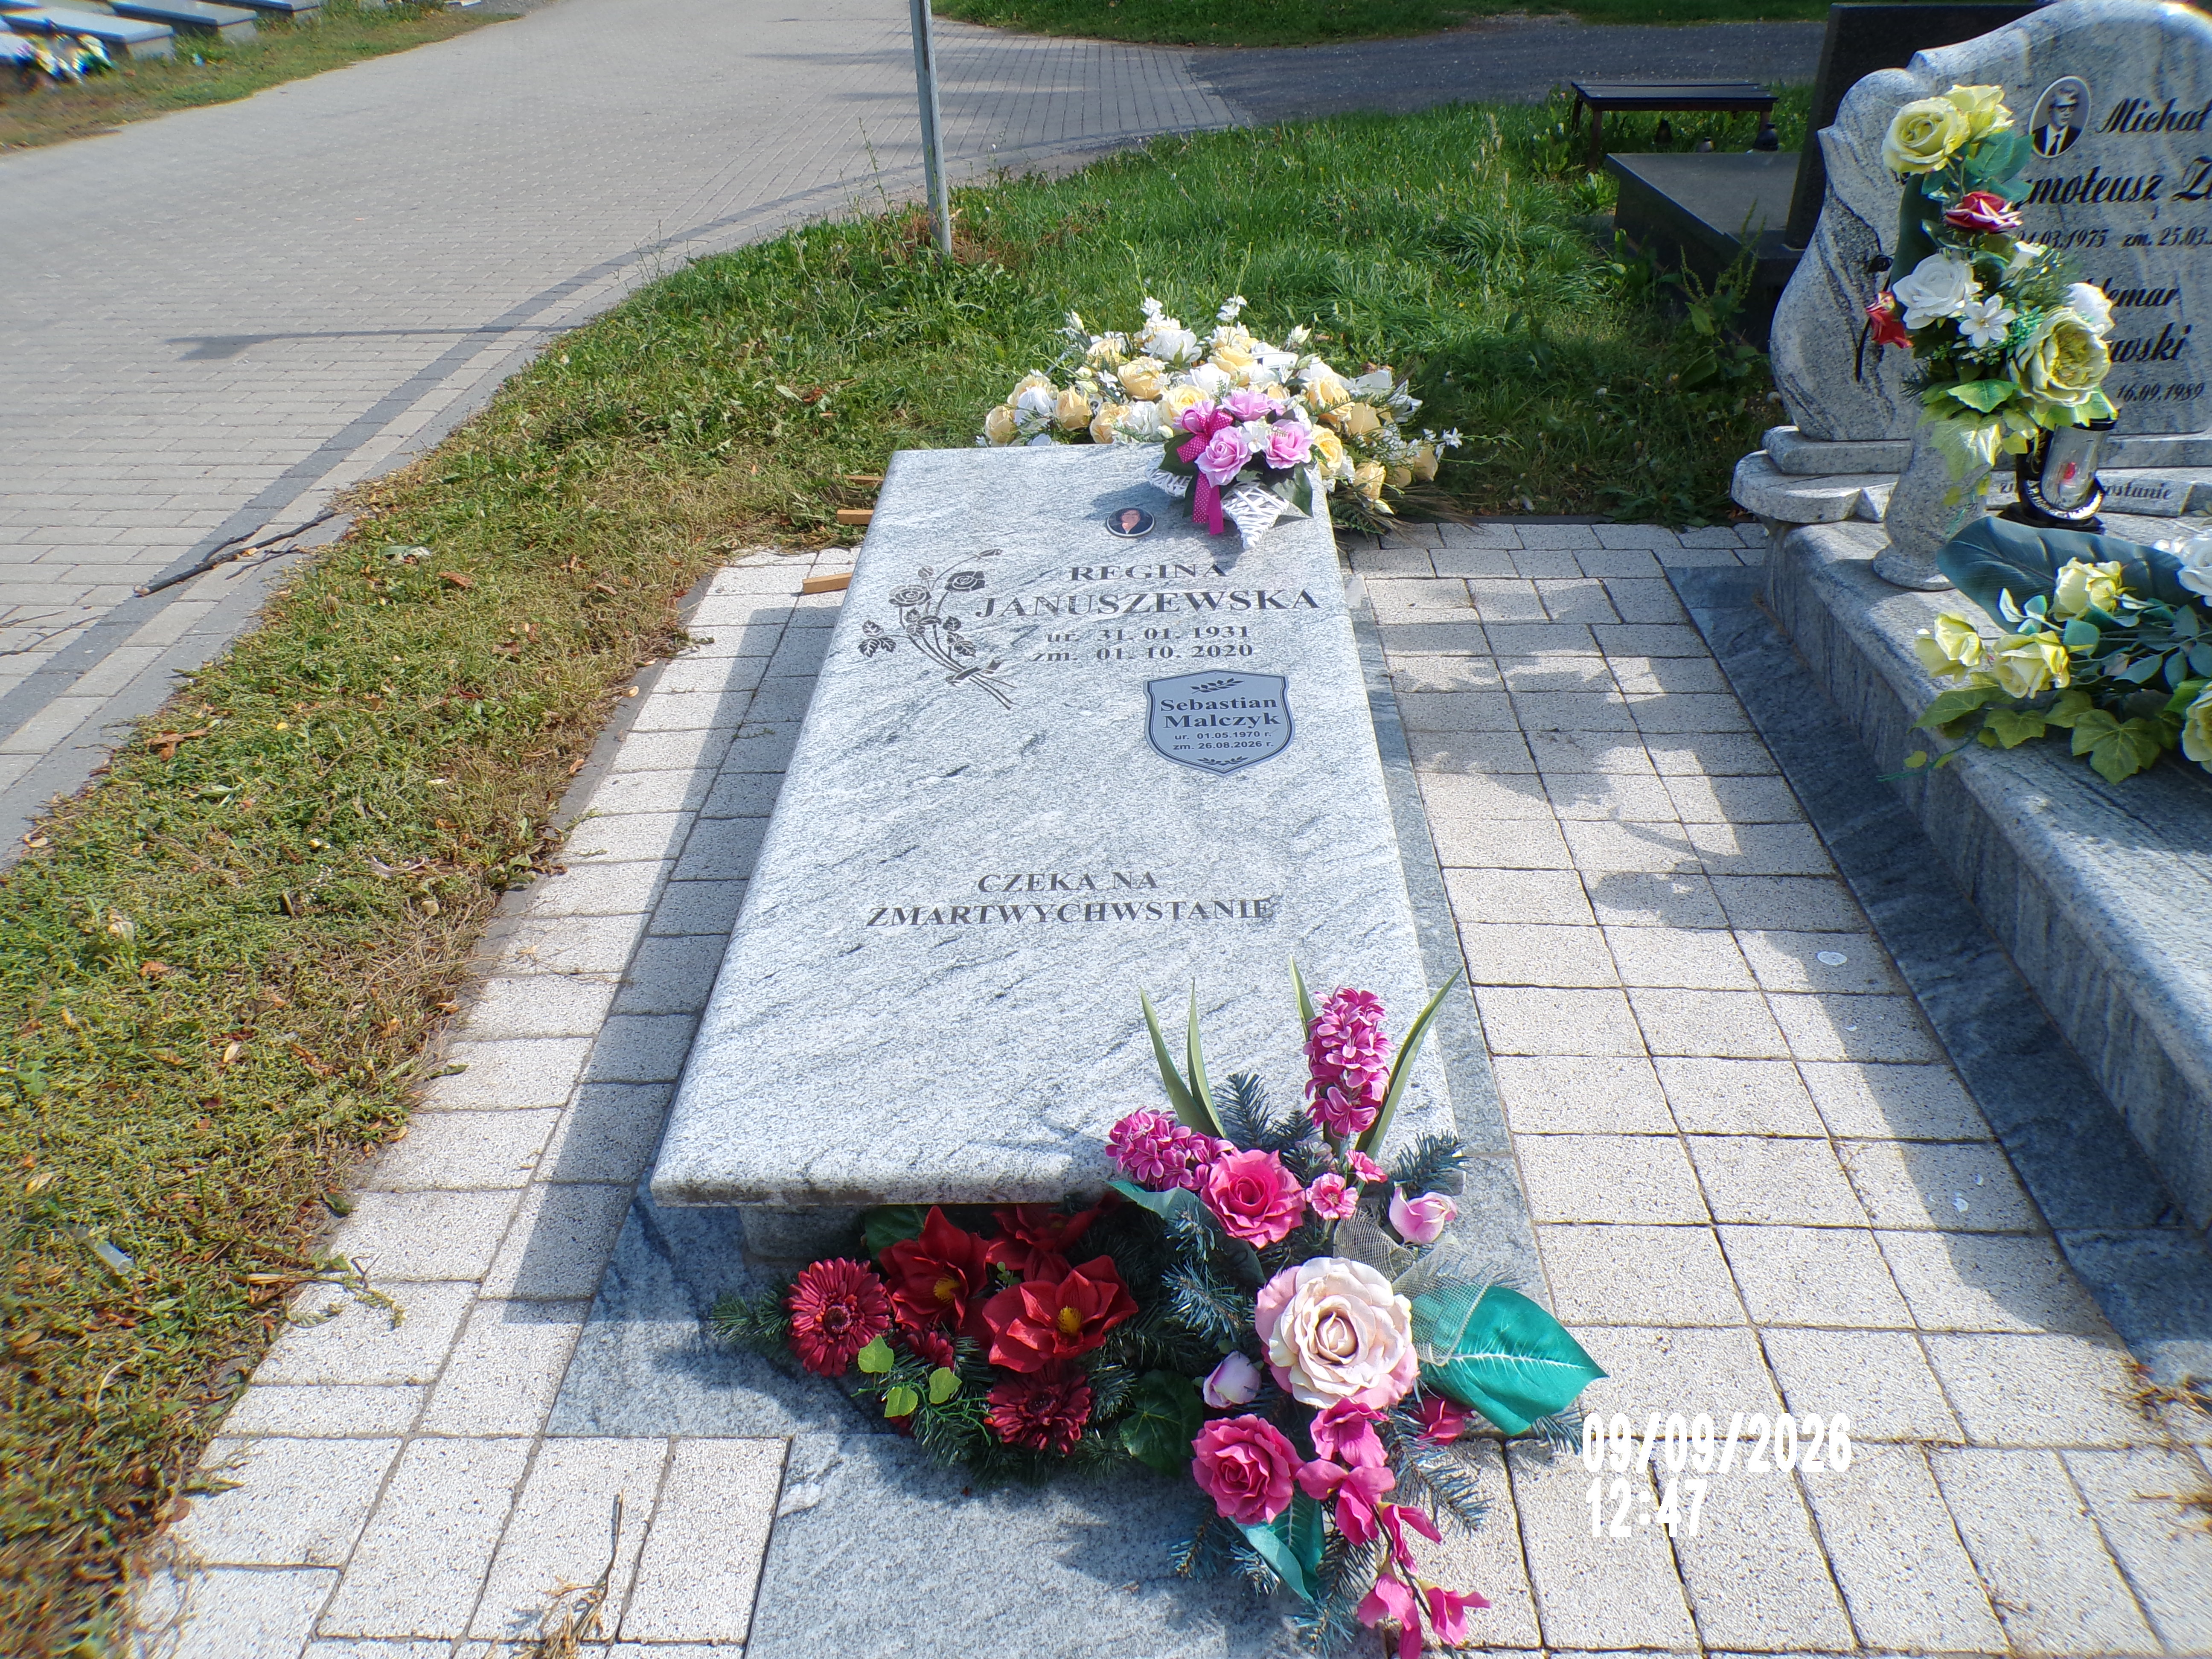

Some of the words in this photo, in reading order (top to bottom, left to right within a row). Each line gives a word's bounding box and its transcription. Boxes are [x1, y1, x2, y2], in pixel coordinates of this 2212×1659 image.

[2011, 166, 2165, 210] moteusz
[2016, 229, 2109, 250] 03.1975
[2157, 226, 2212, 246] 25.03.
[2086, 277, 2180, 307] emar
[2107, 322, 2192, 362] wski
[2116, 383, 2205, 402] 16.09.1989
[1070, 563, 1228, 581] REGINA
[975, 589, 1321, 617] JANUSZEWSKA
[1045, 632, 1080, 643] ur.
[1097, 629, 1134, 641] 31.
[1144, 627, 1181, 640] 01.
[1193, 626, 1249, 639] 1931
[1031, 651, 1078, 662] zm.
[1096, 647, 1133, 660] 01.
[1147, 646, 1181, 659] 10.
[1190, 644, 1253, 658] 2020
[1160, 697, 1278, 711] Sebastian
[1163, 712, 1281, 729] Malczyk
[1197, 731, 1260, 739] 01.05.1970
[1198, 741, 1262, 749] 26.08.2026
[978, 872, 1096, 893] CZEKA
[1112, 871, 1159, 890] NA
[865, 897, 1274, 926] ZMARTWYCHWSTANIE
